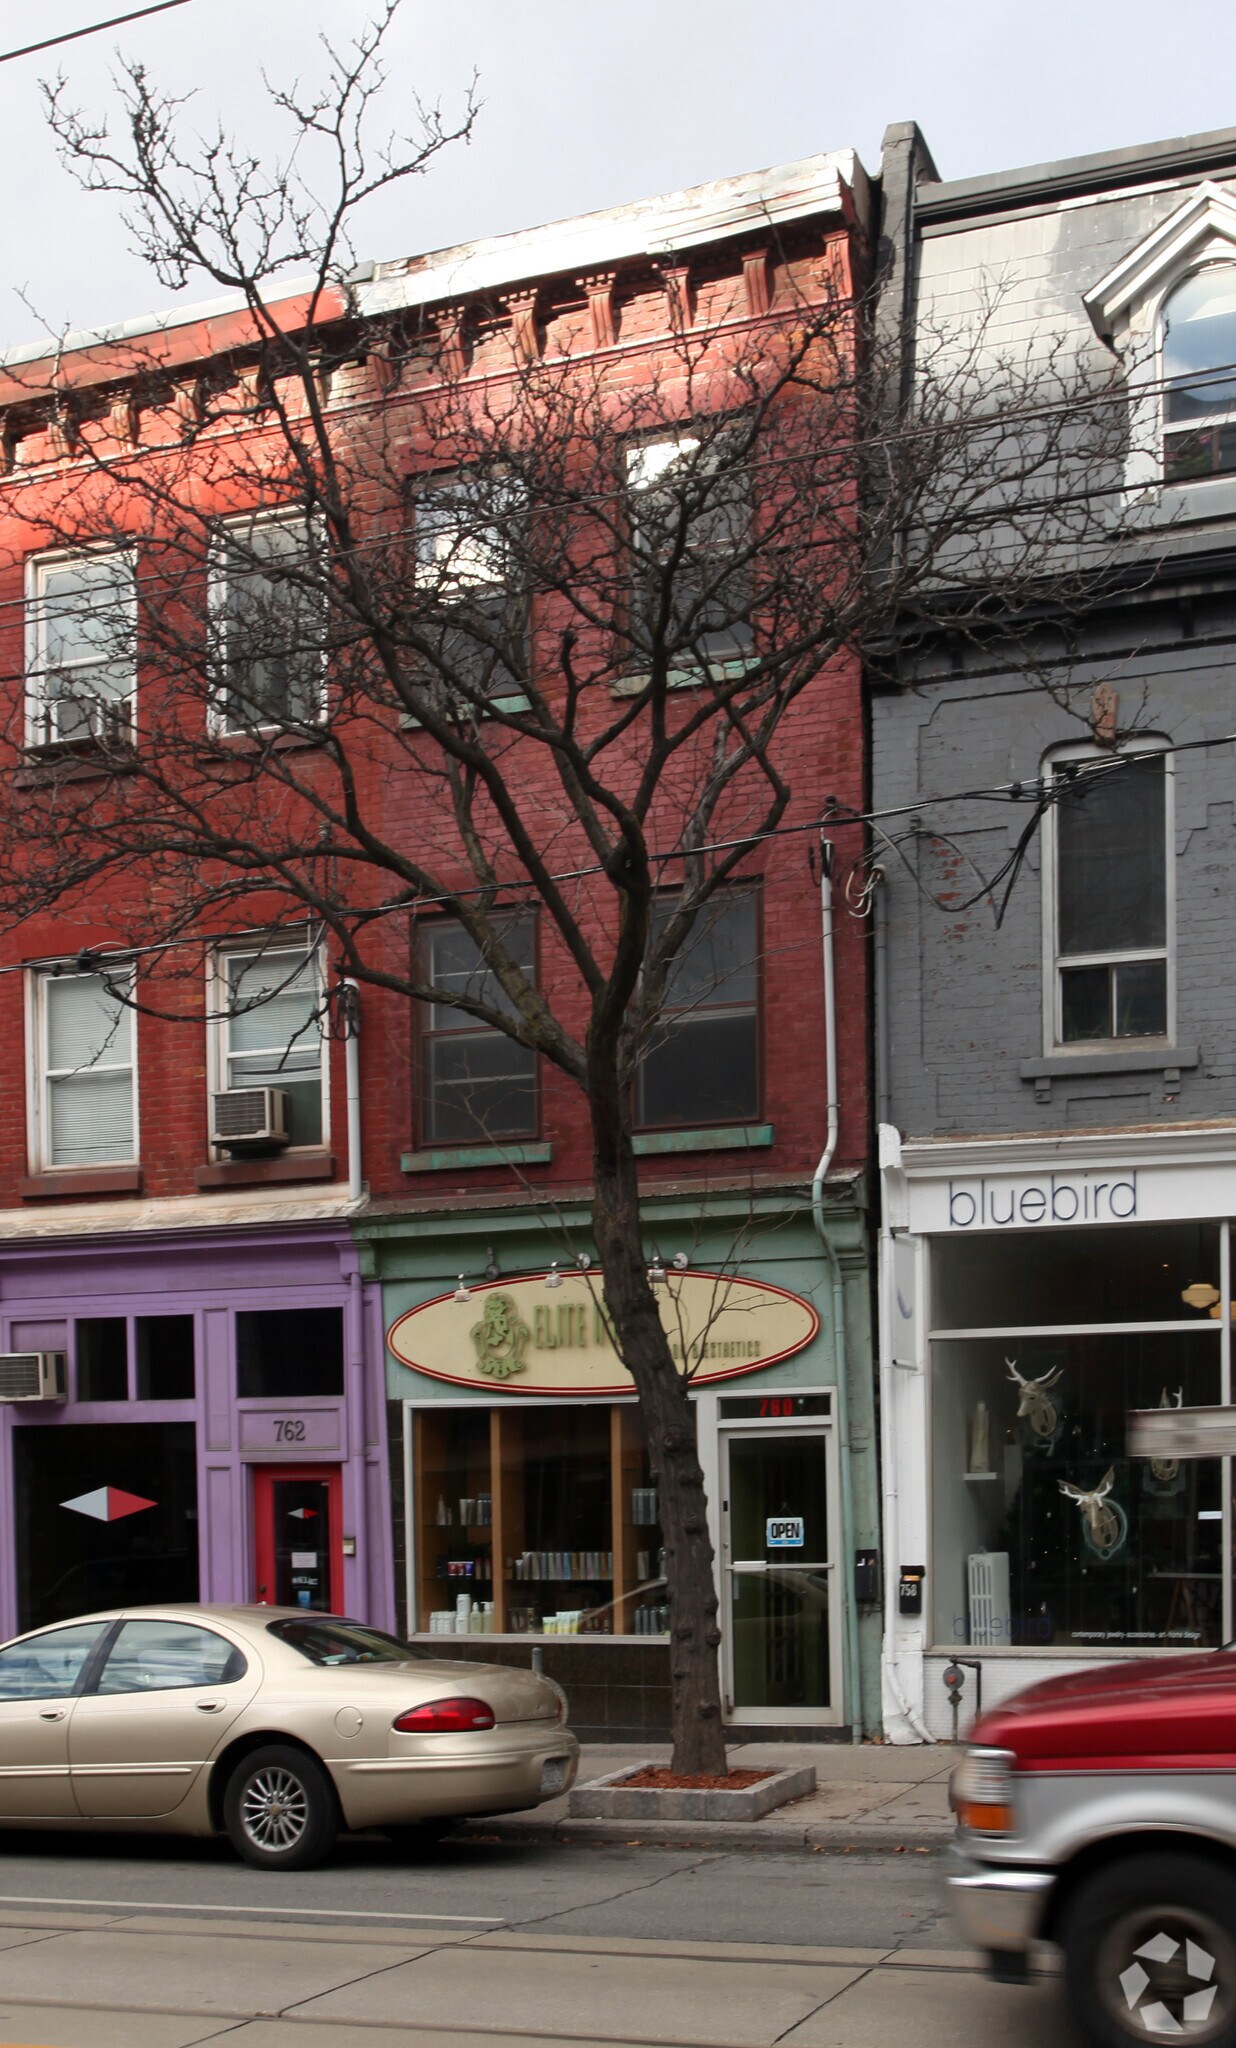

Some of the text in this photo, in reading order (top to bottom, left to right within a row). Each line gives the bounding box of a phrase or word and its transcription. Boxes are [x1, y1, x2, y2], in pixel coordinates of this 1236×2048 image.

[949, 1170, 1137, 1226] bluebird
[534, 1303, 586, 1350] ELITE
[702, 1340, 761, 1360] ESTHETICS
[273, 1420, 306, 1442] 762
[771, 1522, 800, 1539] OPEN
[900, 1583, 917, 1597] 758
